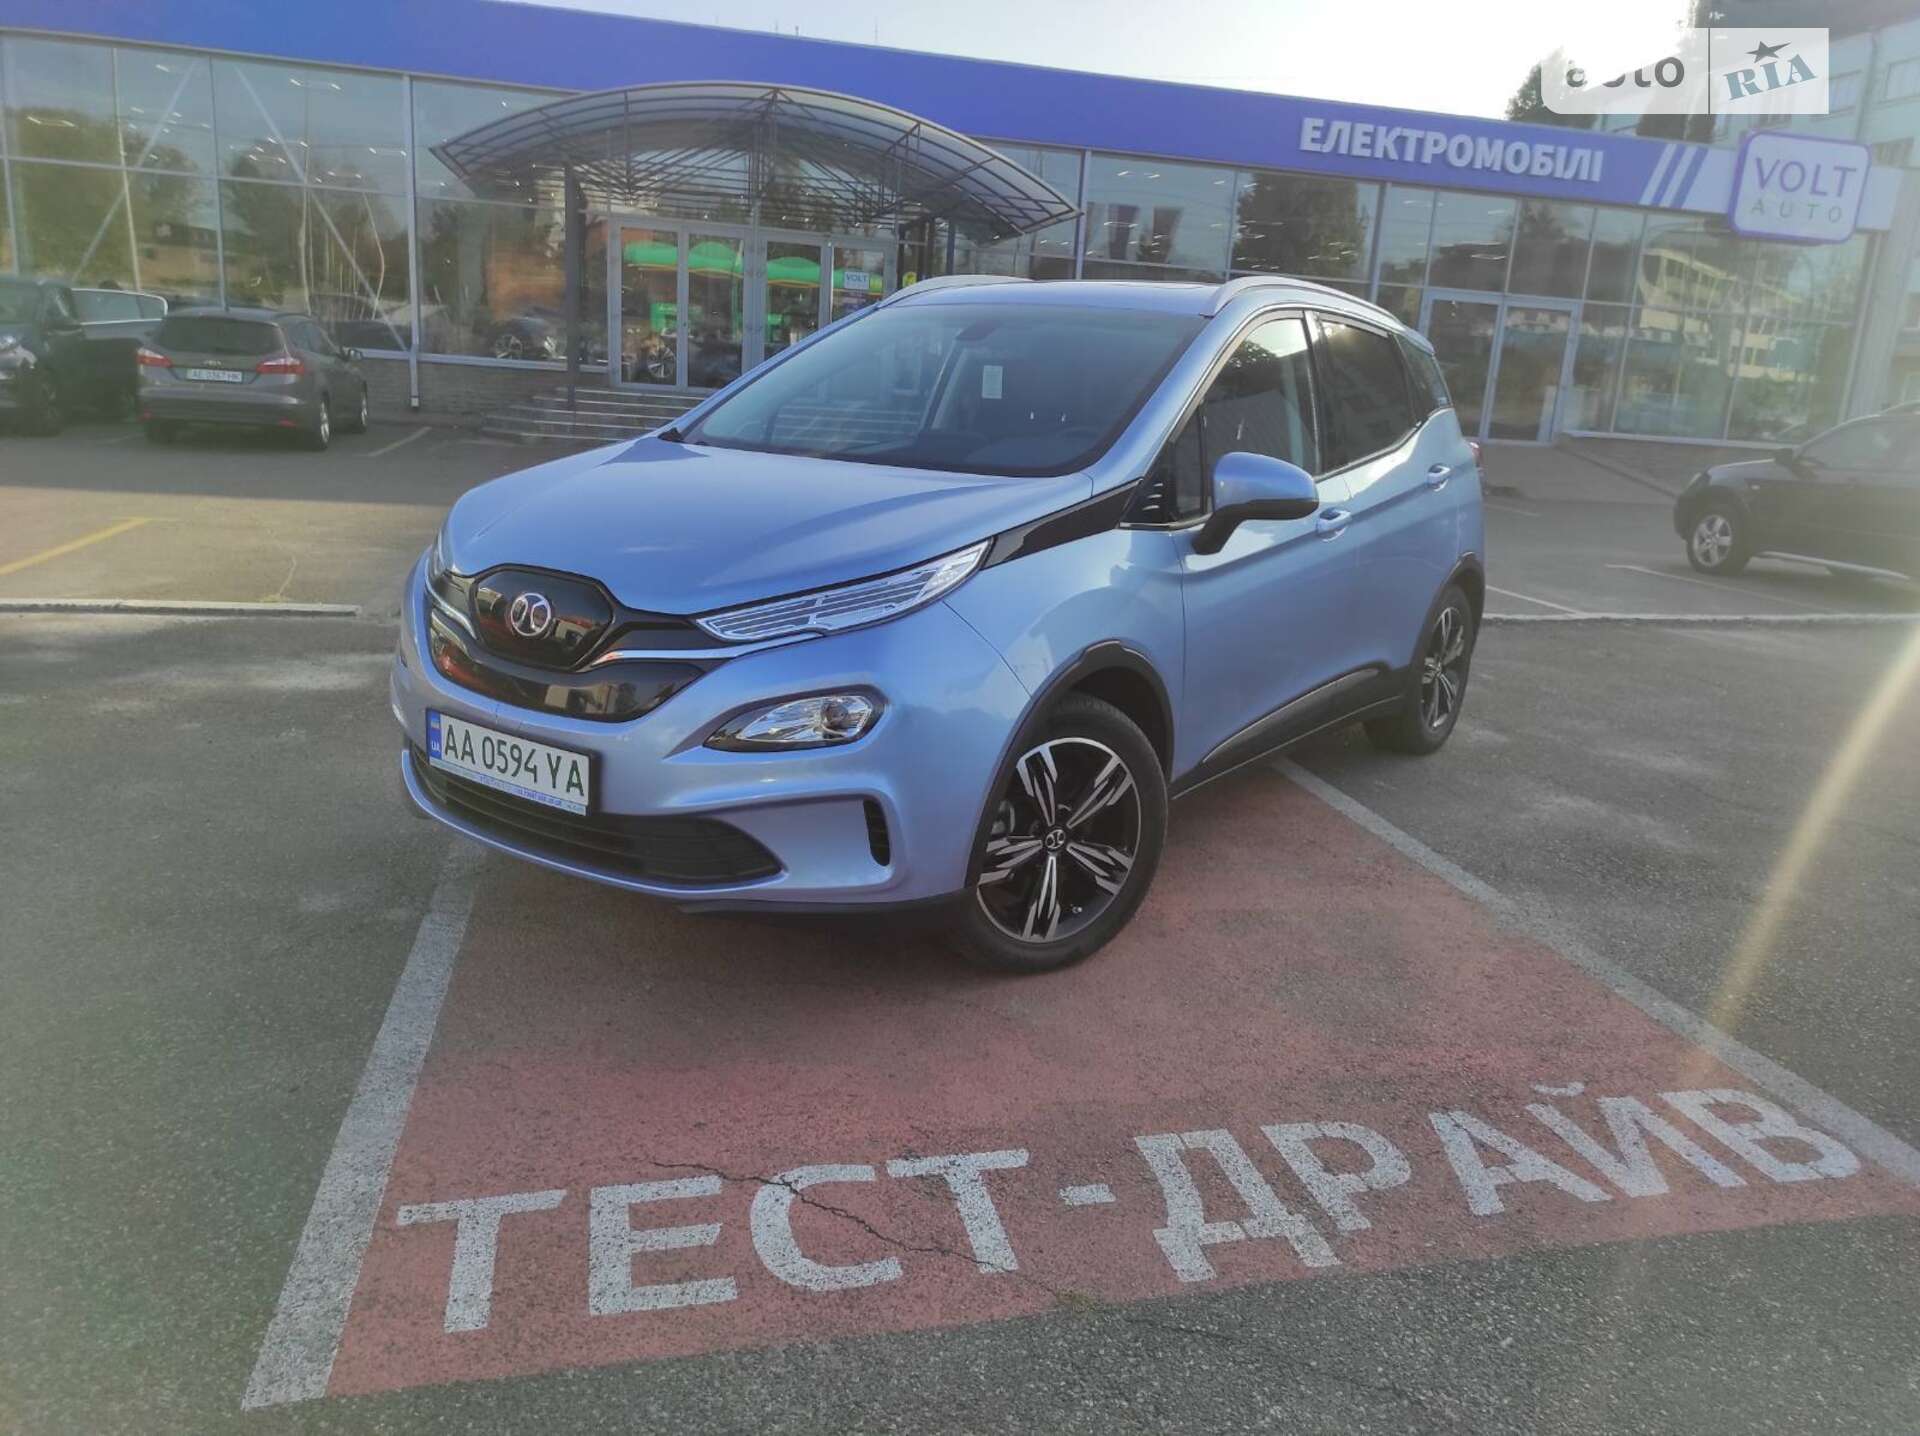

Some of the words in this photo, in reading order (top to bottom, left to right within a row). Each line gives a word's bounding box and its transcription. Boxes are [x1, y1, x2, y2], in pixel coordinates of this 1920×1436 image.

[1300, 117, 1604, 182] ЕЛЕКТРОМОБІЛІ
[1755, 157, 1857, 197] VOLT
[1750, 198, 1842, 223] AUTO
[444, 724, 476, 765] AA
[481, 735, 538, 784] 0594
[546, 753, 585, 797] YA
[398, 1081, 1862, 1333] ТЕСТ-ДРАЙВ
